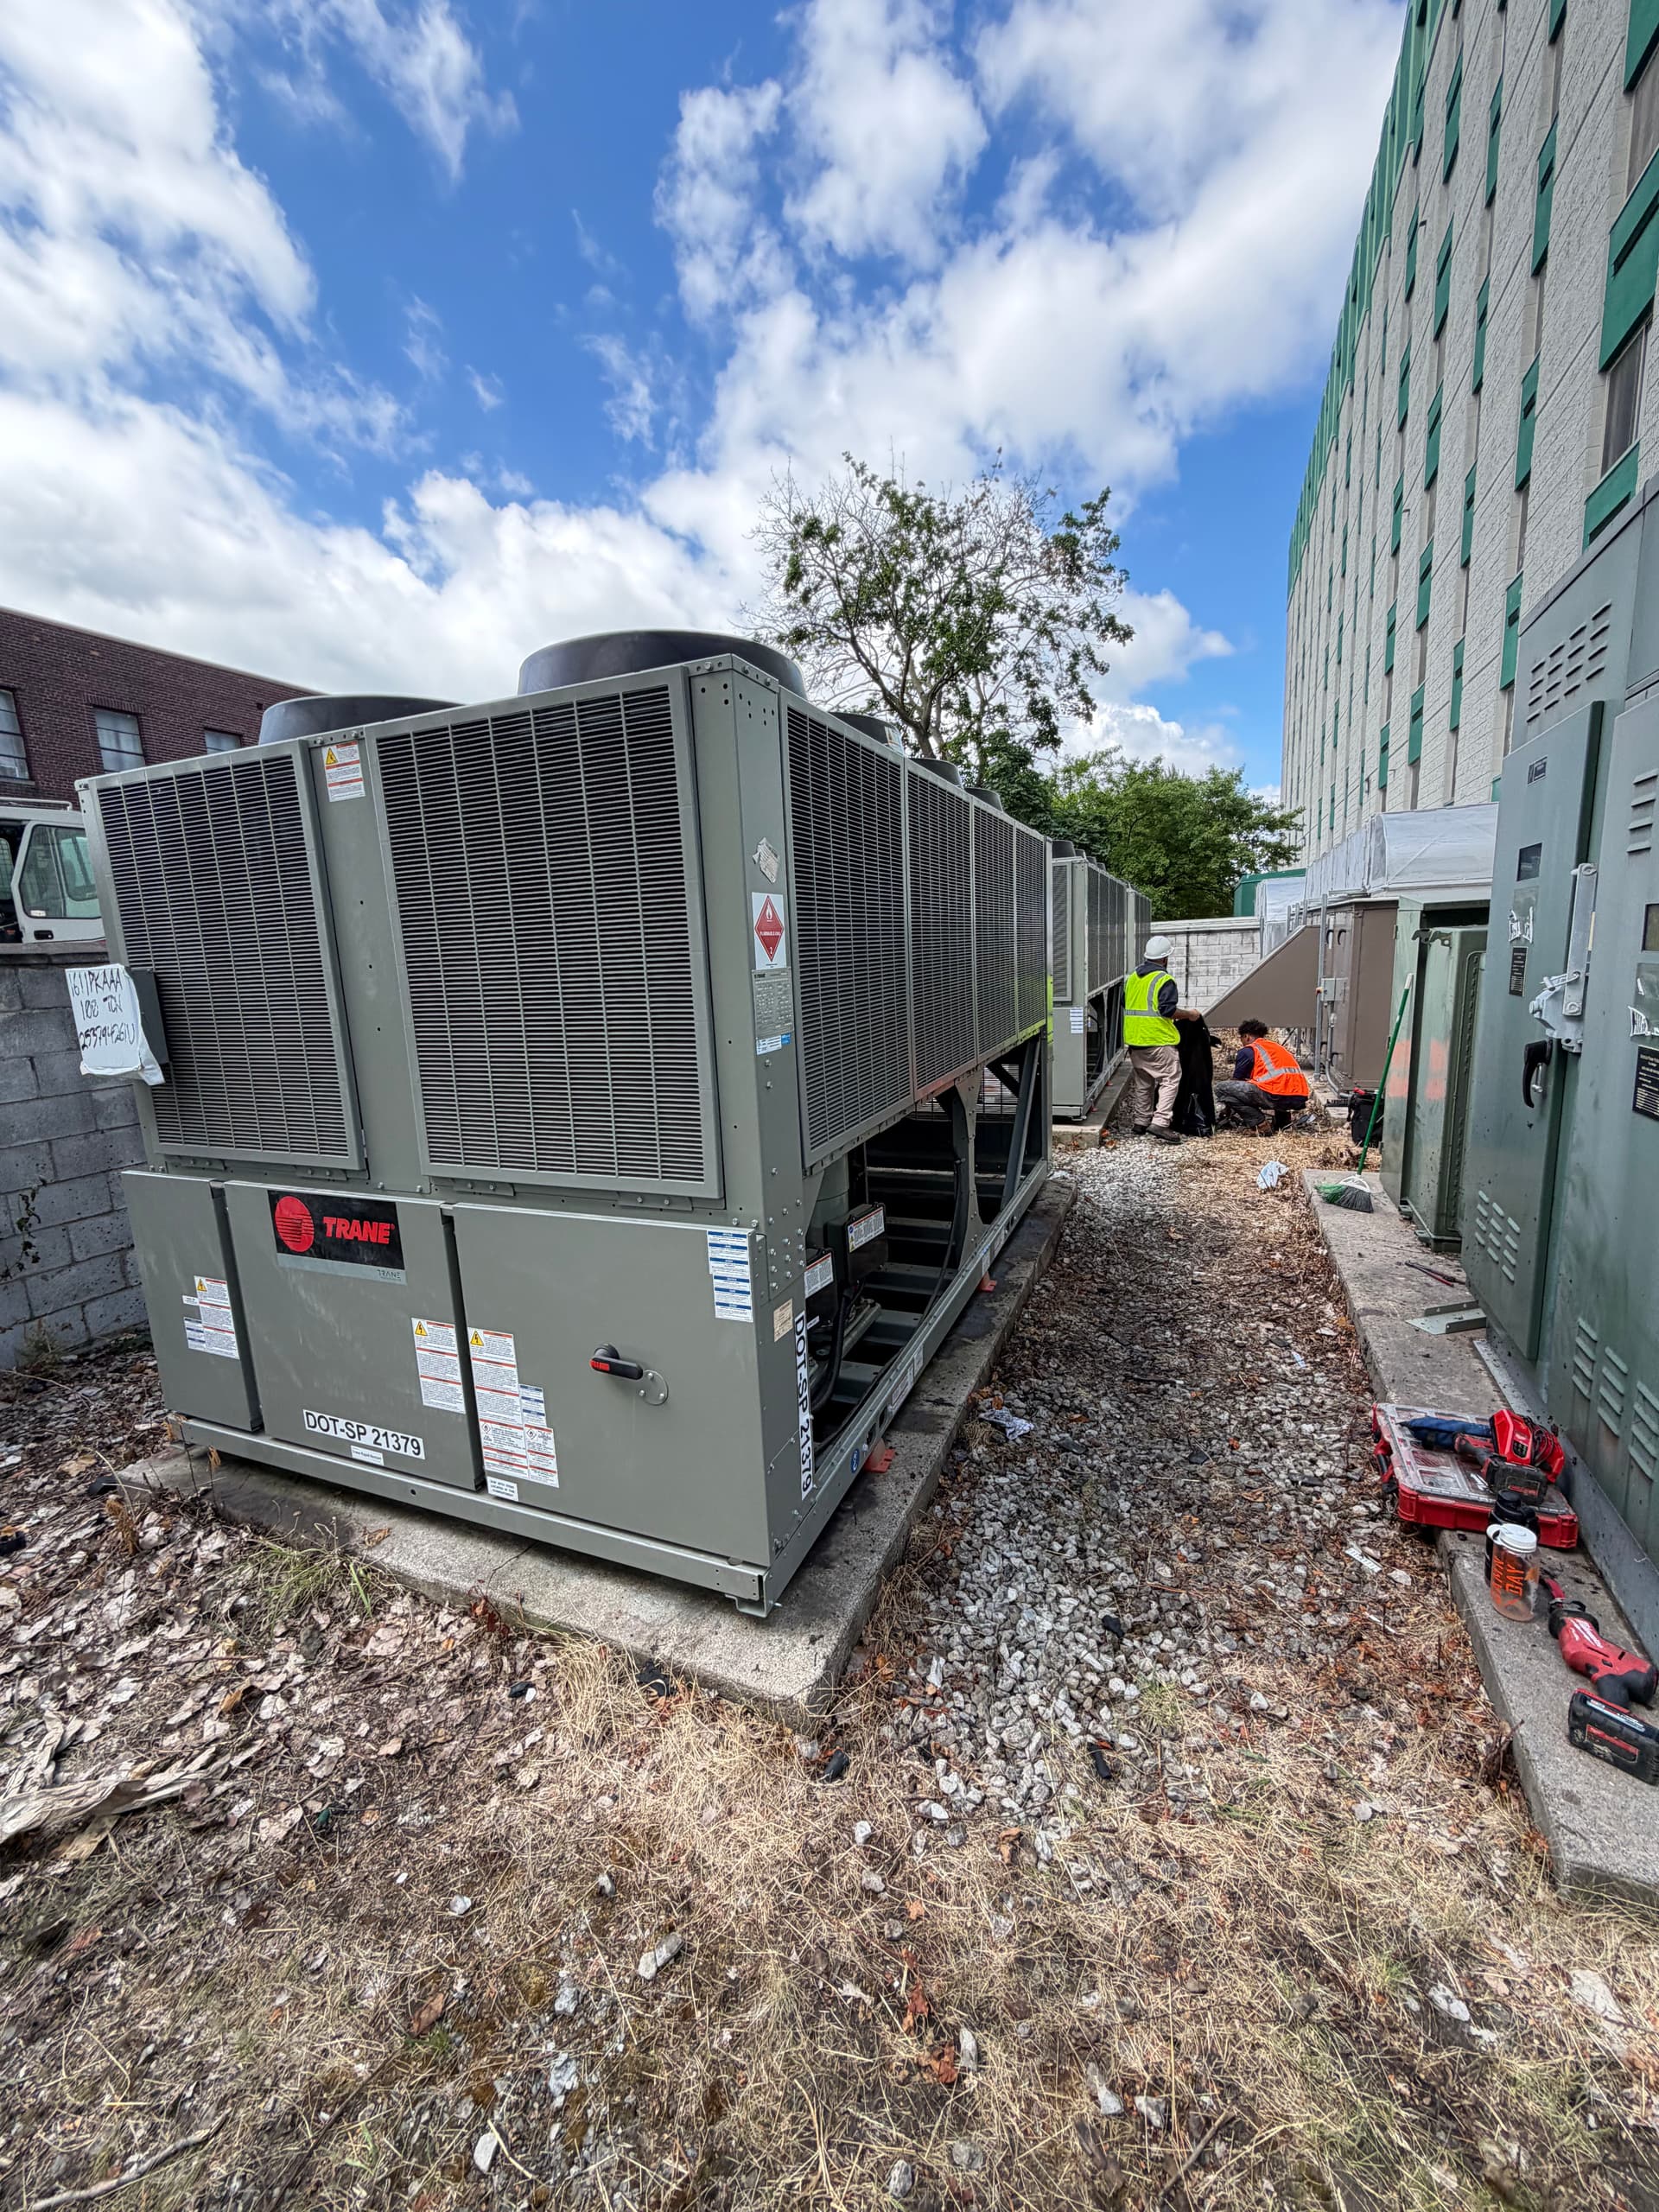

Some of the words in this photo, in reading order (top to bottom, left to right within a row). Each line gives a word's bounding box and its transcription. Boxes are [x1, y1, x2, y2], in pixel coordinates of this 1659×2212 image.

[322, 1217, 391, 1245] TRANE
[796, 1315, 808, 1413] DOT-SP
[305, 1411, 367, 1441] DOT-SP
[372, 1428, 421, 1456] 21379
[800, 1419, 812, 1492] 21379
[1505, 1563, 1524, 1597] DAY
